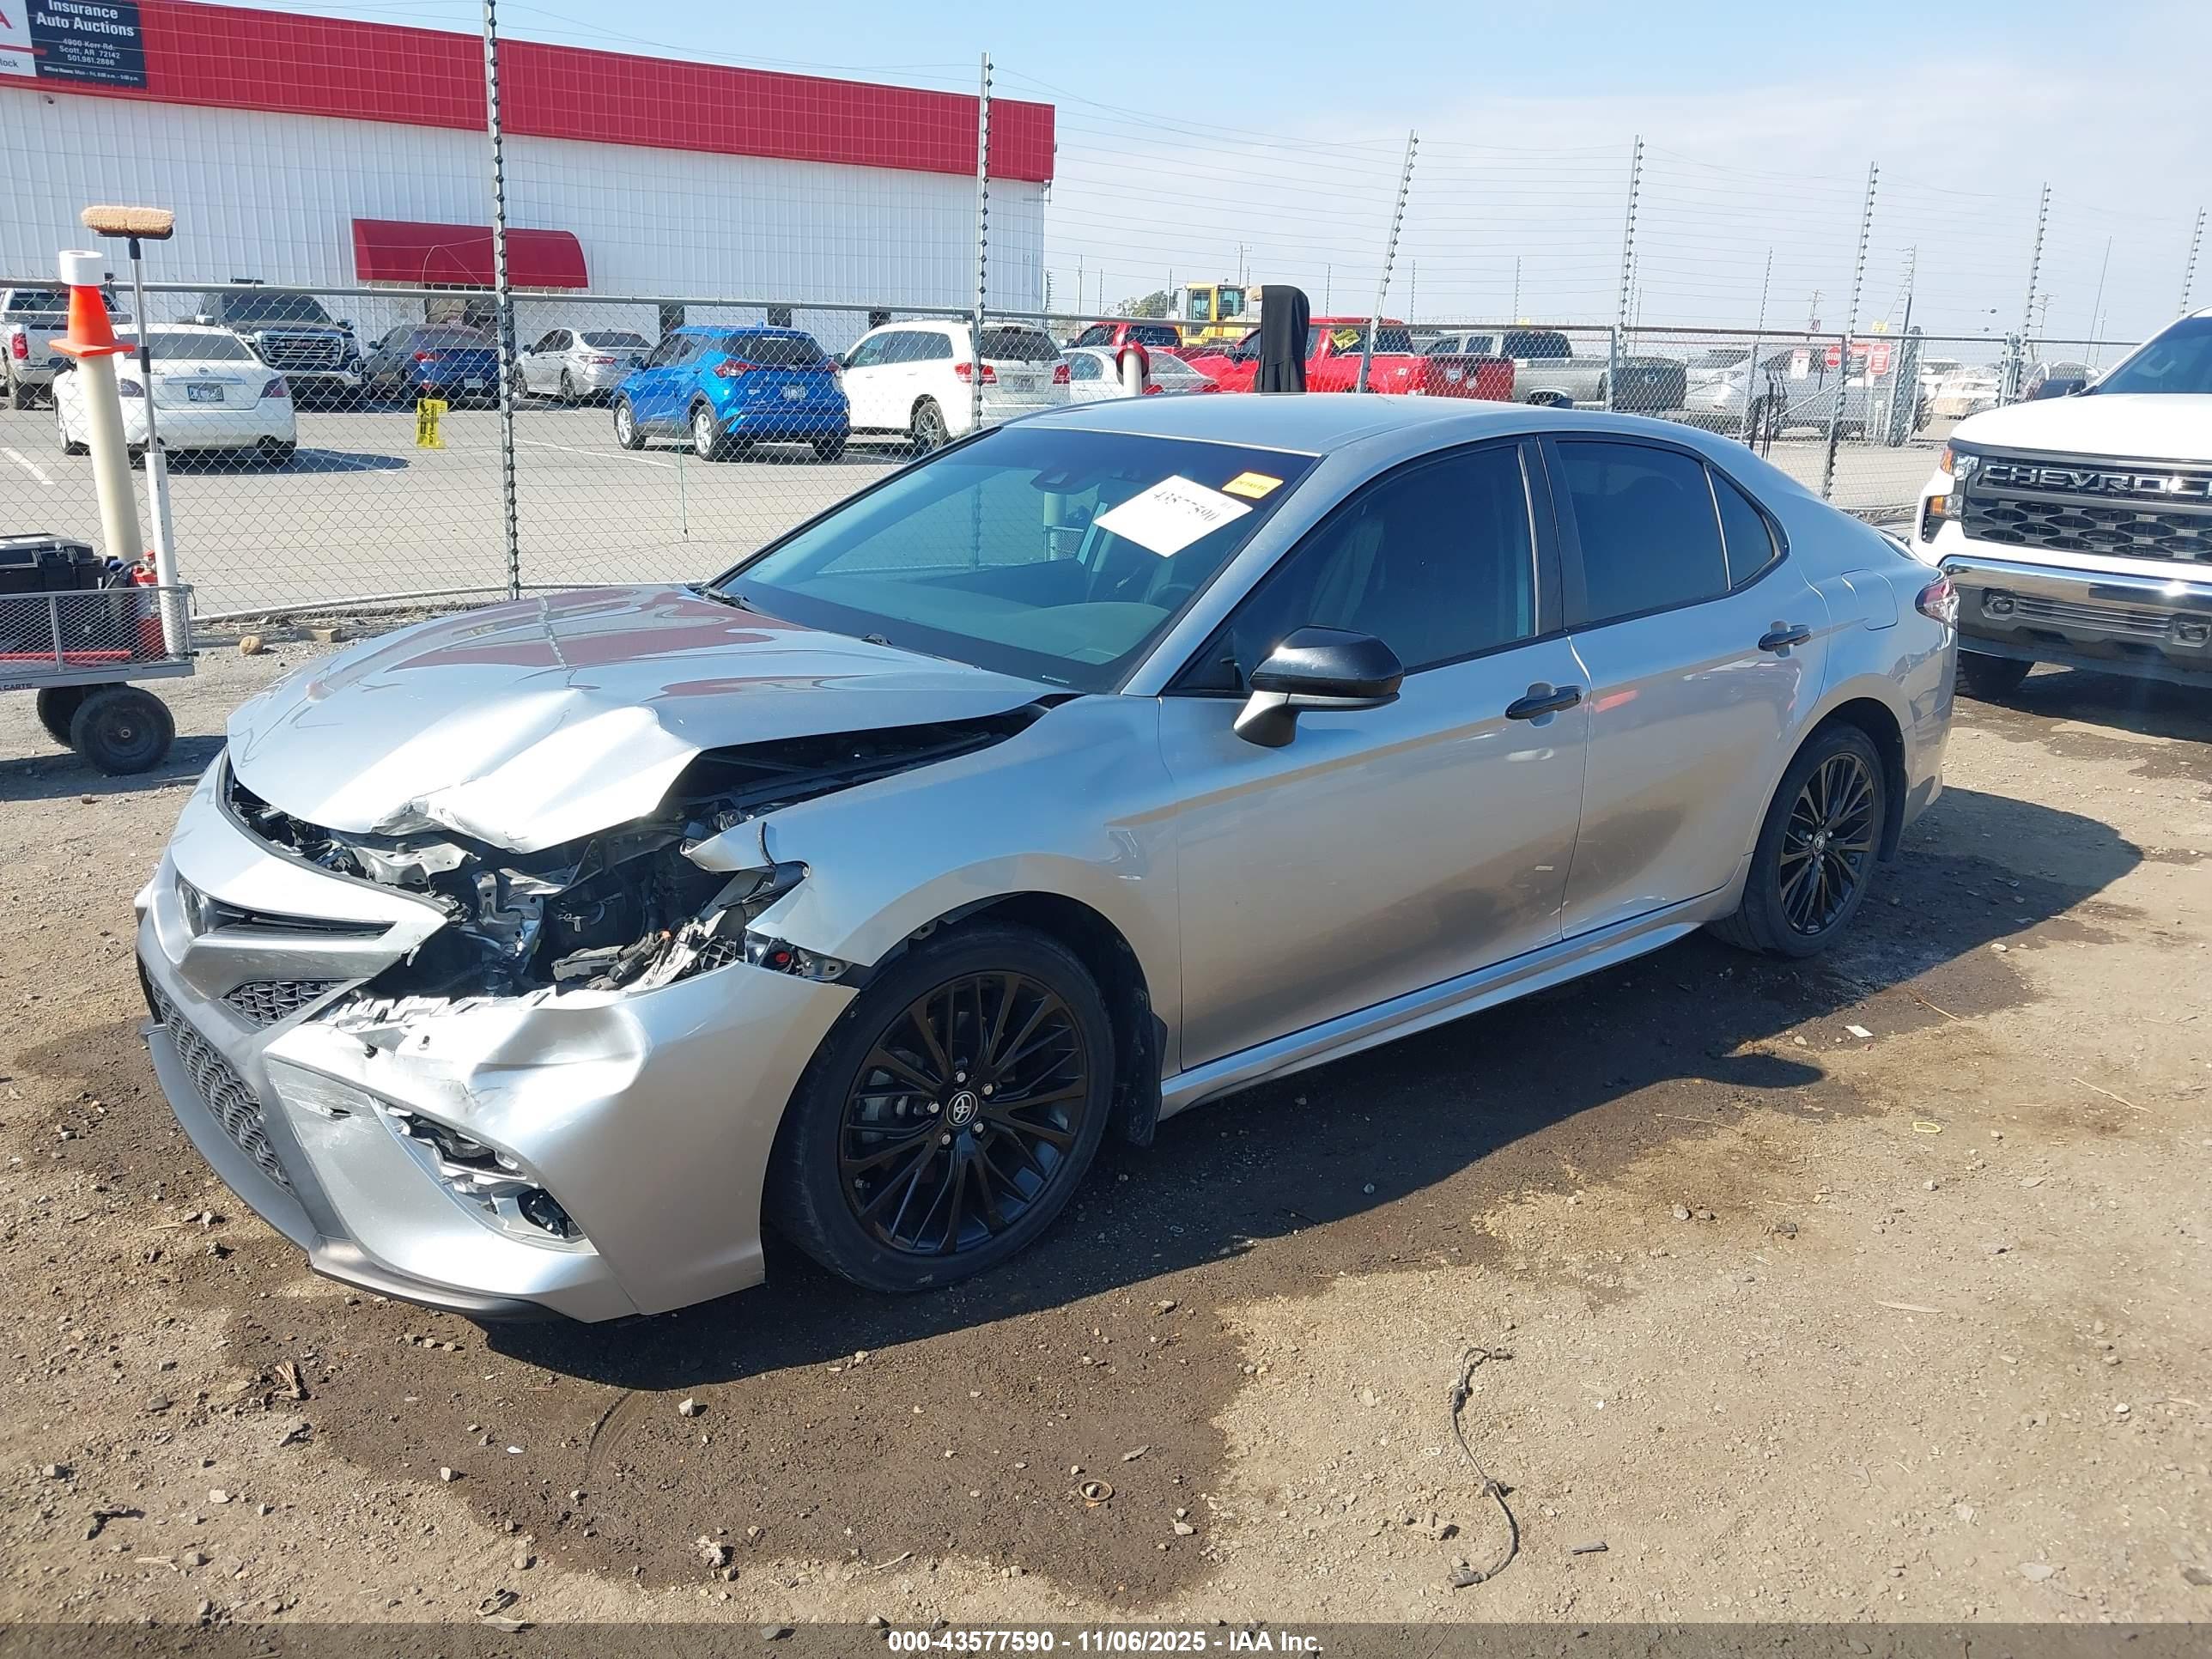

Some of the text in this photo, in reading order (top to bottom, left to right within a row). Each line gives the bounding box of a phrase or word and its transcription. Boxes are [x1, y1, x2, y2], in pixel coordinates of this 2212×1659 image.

[48, 0, 118, 19] Insurance
[36, 12, 135, 37] Auto Auctions
[58, 45, 82, 55] Scott,
[98, 50, 120, 59] 72142
[84, 40, 100, 49] Kerr
[1810, 319, 1820, 332] 40
[1983, 465, 2212, 496] CHEVROL
